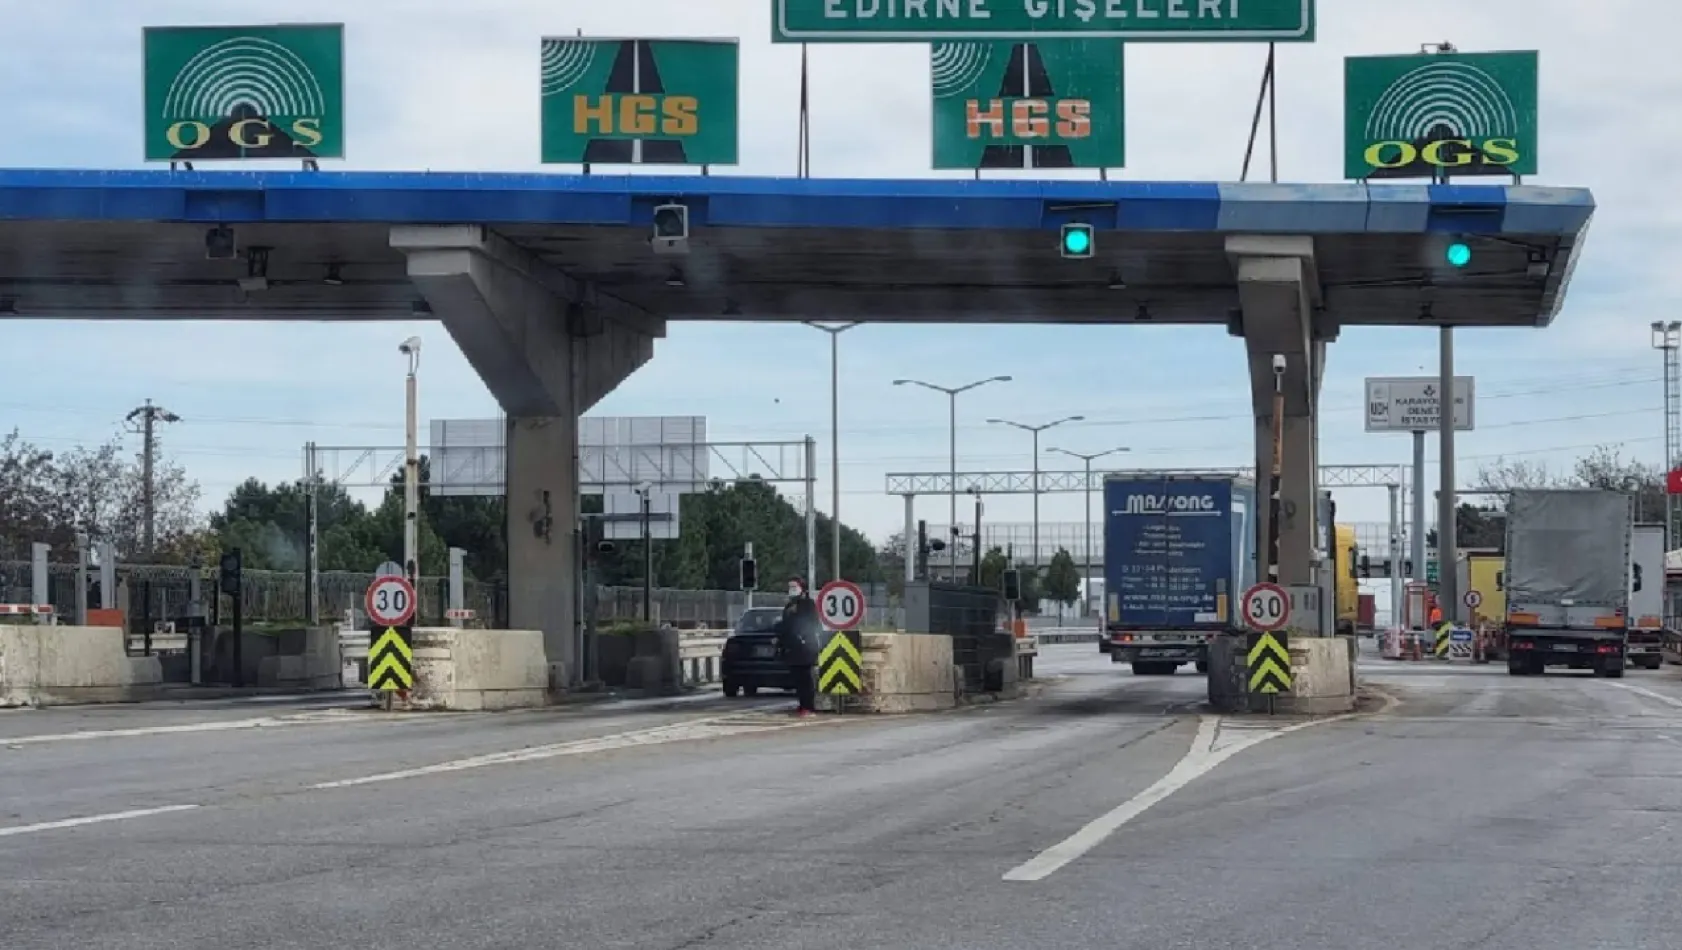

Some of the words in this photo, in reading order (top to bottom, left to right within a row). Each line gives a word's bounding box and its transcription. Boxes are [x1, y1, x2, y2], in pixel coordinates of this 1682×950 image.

[573, 95, 698, 135] HGS
[966, 99, 1091, 138] HGS
[166, 118, 323, 149] OGS
[1364, 138, 1519, 168] OGS
[377, 590, 406, 611] 30
[827, 595, 855, 617] 30
[1252, 596, 1281, 618] 30
